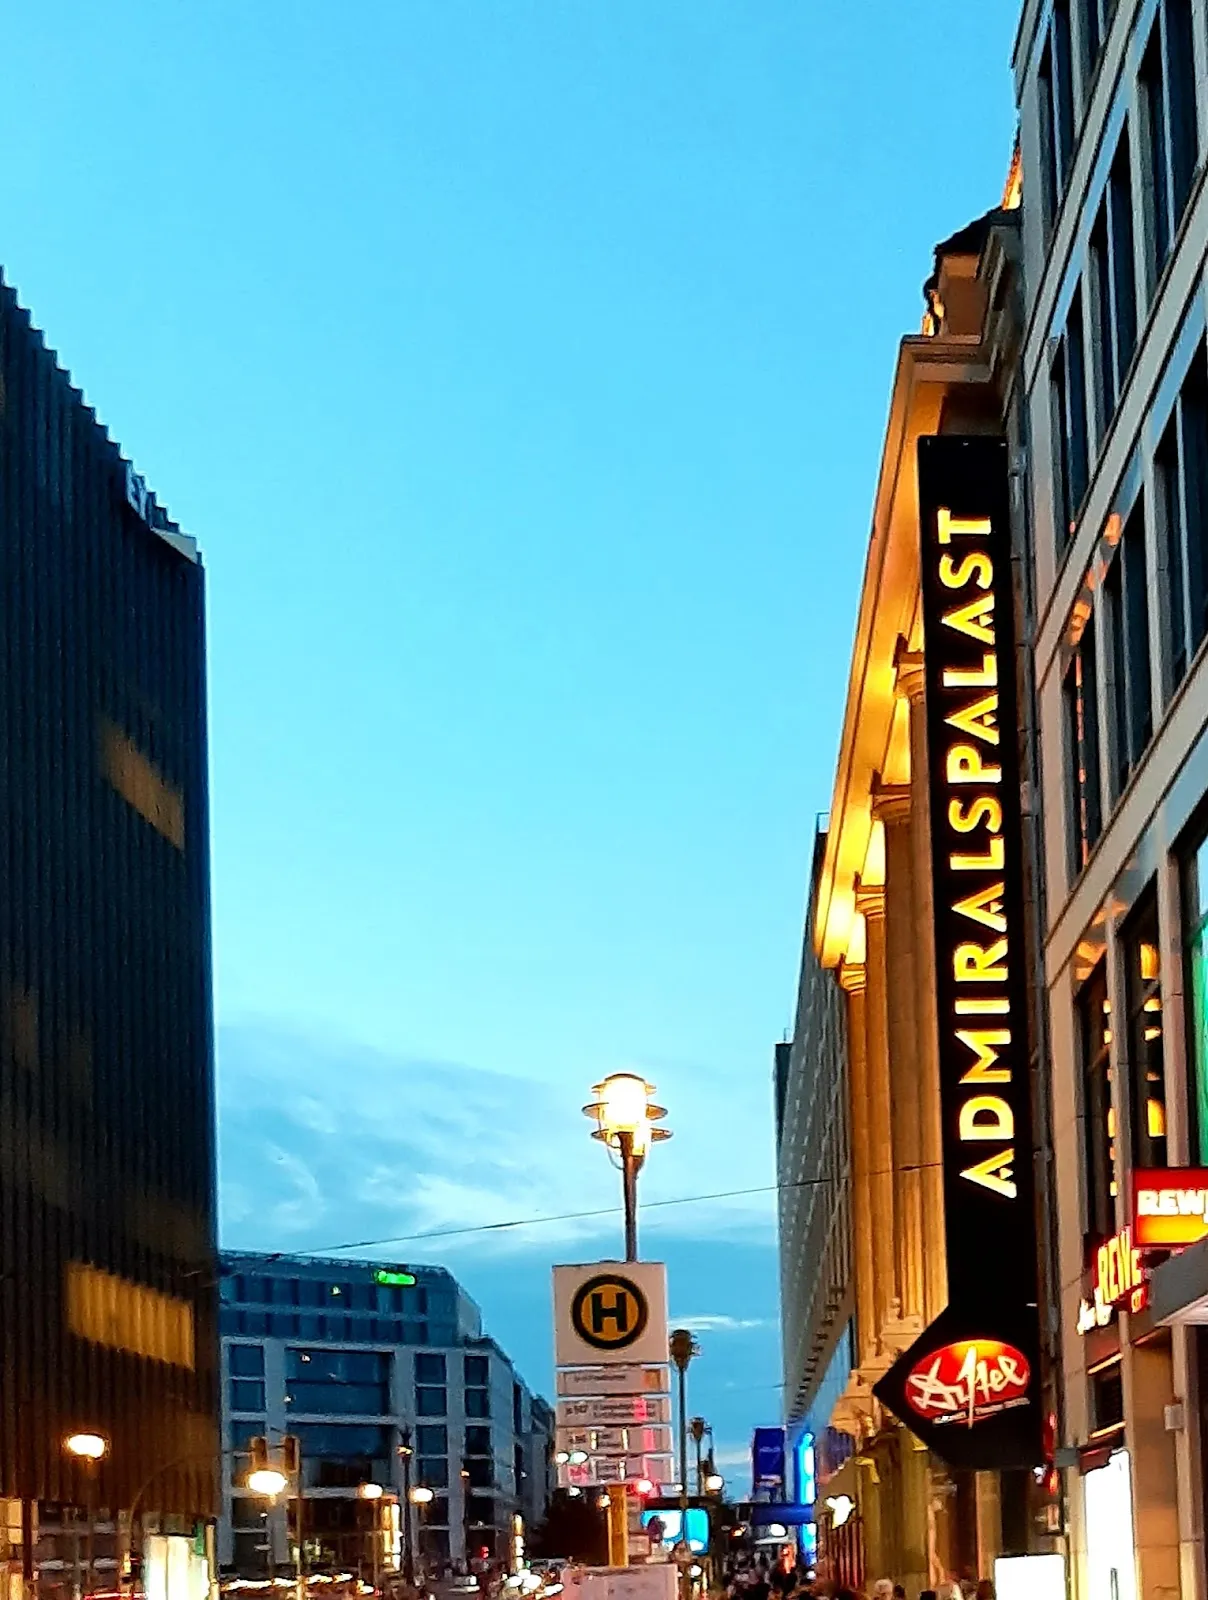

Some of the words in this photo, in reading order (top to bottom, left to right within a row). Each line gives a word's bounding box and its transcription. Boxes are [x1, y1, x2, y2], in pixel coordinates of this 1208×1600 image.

[936, 507, 1018, 1200] ADMIRALSPALAST
[1137, 1189, 1208, 1224] REW
[591, 1291, 628, 1334] H
